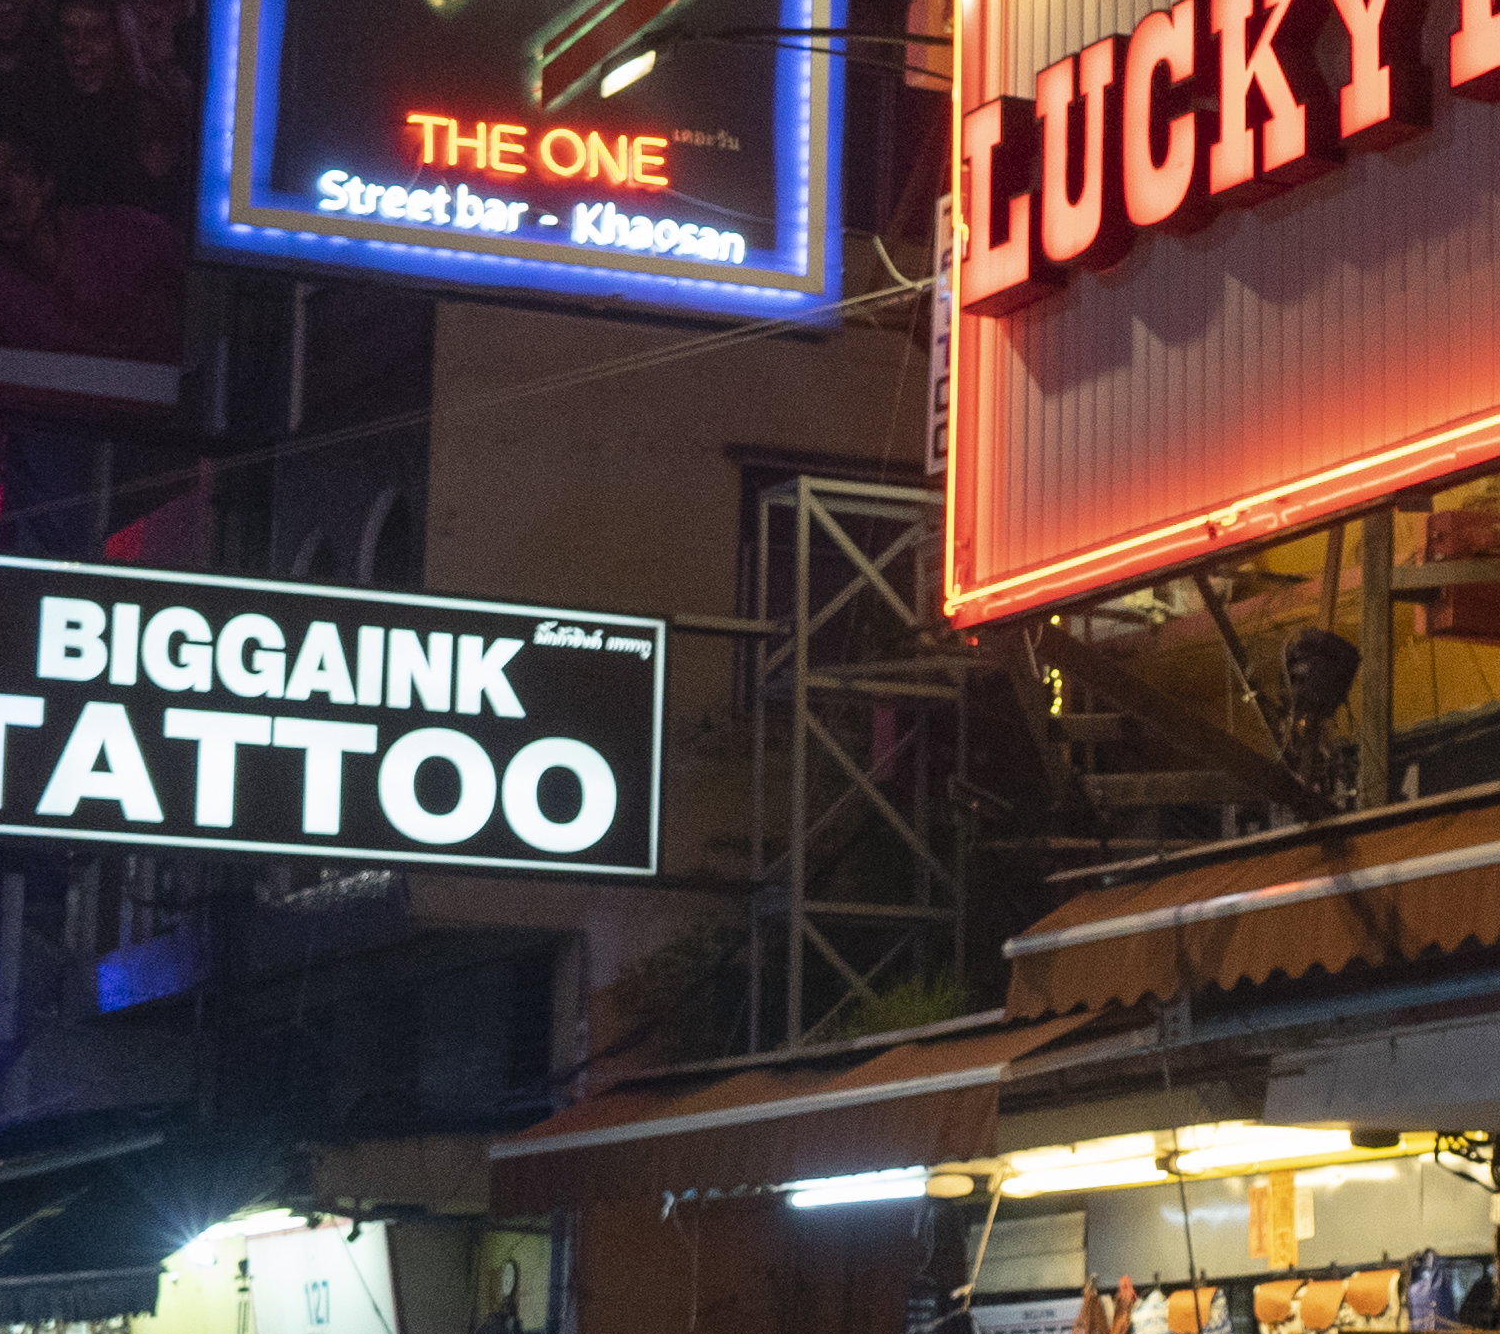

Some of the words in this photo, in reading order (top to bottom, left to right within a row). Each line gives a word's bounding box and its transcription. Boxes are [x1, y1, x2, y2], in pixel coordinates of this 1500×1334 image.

[407, 113, 527, 174] THE
[540, 128, 669, 186] ONE
[318, 169, 450, 224] Street
[455, 184, 529, 233] bar
[571, 201, 747, 264] Khaosan
[35, 595, 526, 719] BIGGAINK
